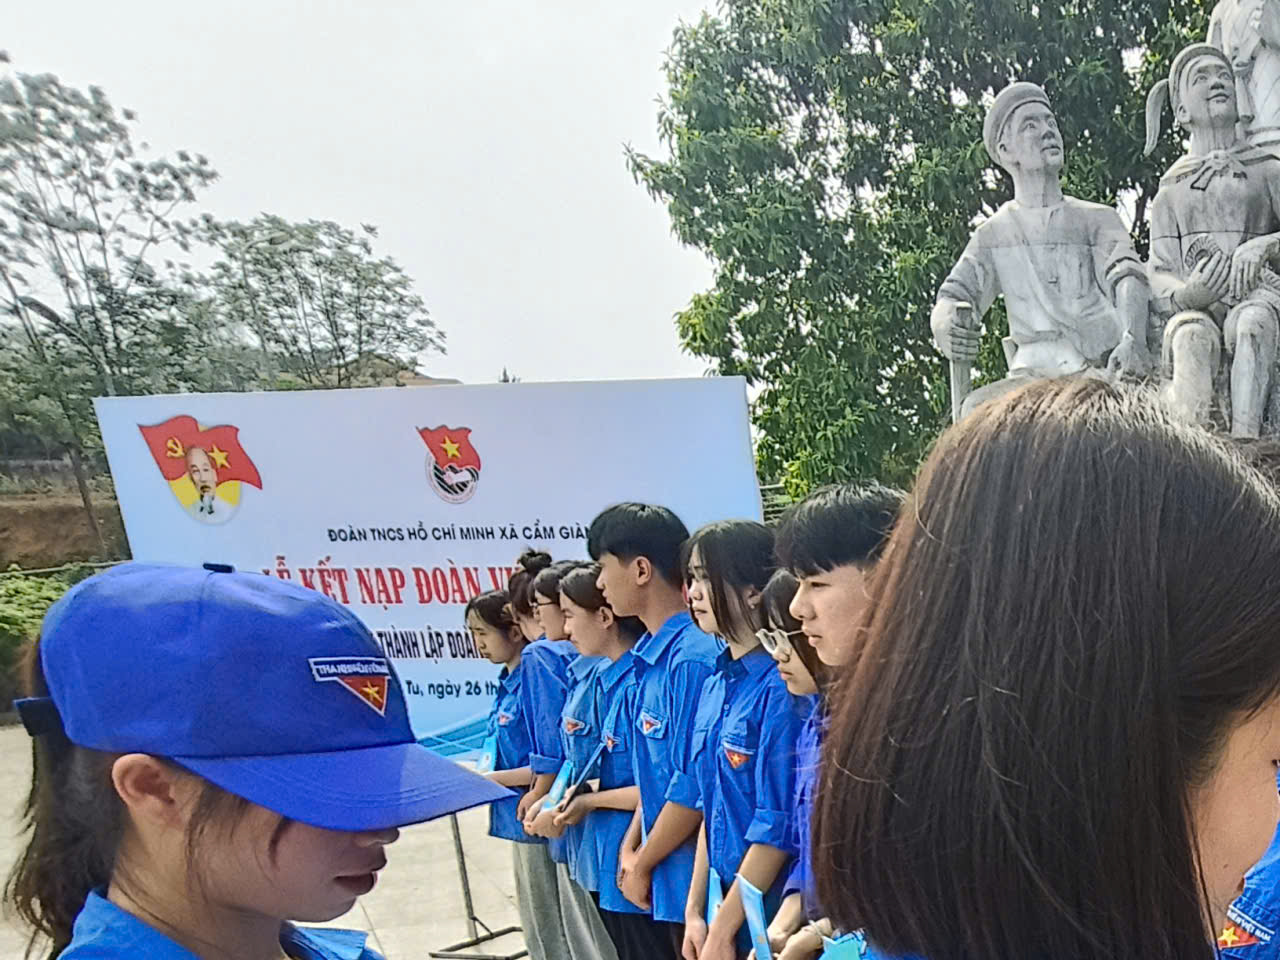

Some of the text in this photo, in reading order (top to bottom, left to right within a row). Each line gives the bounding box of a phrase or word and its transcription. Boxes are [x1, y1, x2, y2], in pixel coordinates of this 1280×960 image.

[327, 524, 368, 542] ĐOÀN
[369, 527, 405, 541] TNCS
[406, 520, 428, 541] HỒ
[431, 523, 456, 541] CHÍ
[459, 526, 495, 540] MINH
[498, 523, 519, 540] XÃ
[354, 566, 405, 611] NẠP
[411, 558, 481, 605] ĐOÀN
[375, 624, 421, 659] THÀNH
[420, 624, 444, 664] LẬP
[405, 680, 424, 696] Tu,
[427, 678, 461, 699] ngày
[465, 681, 482, 696] 26
